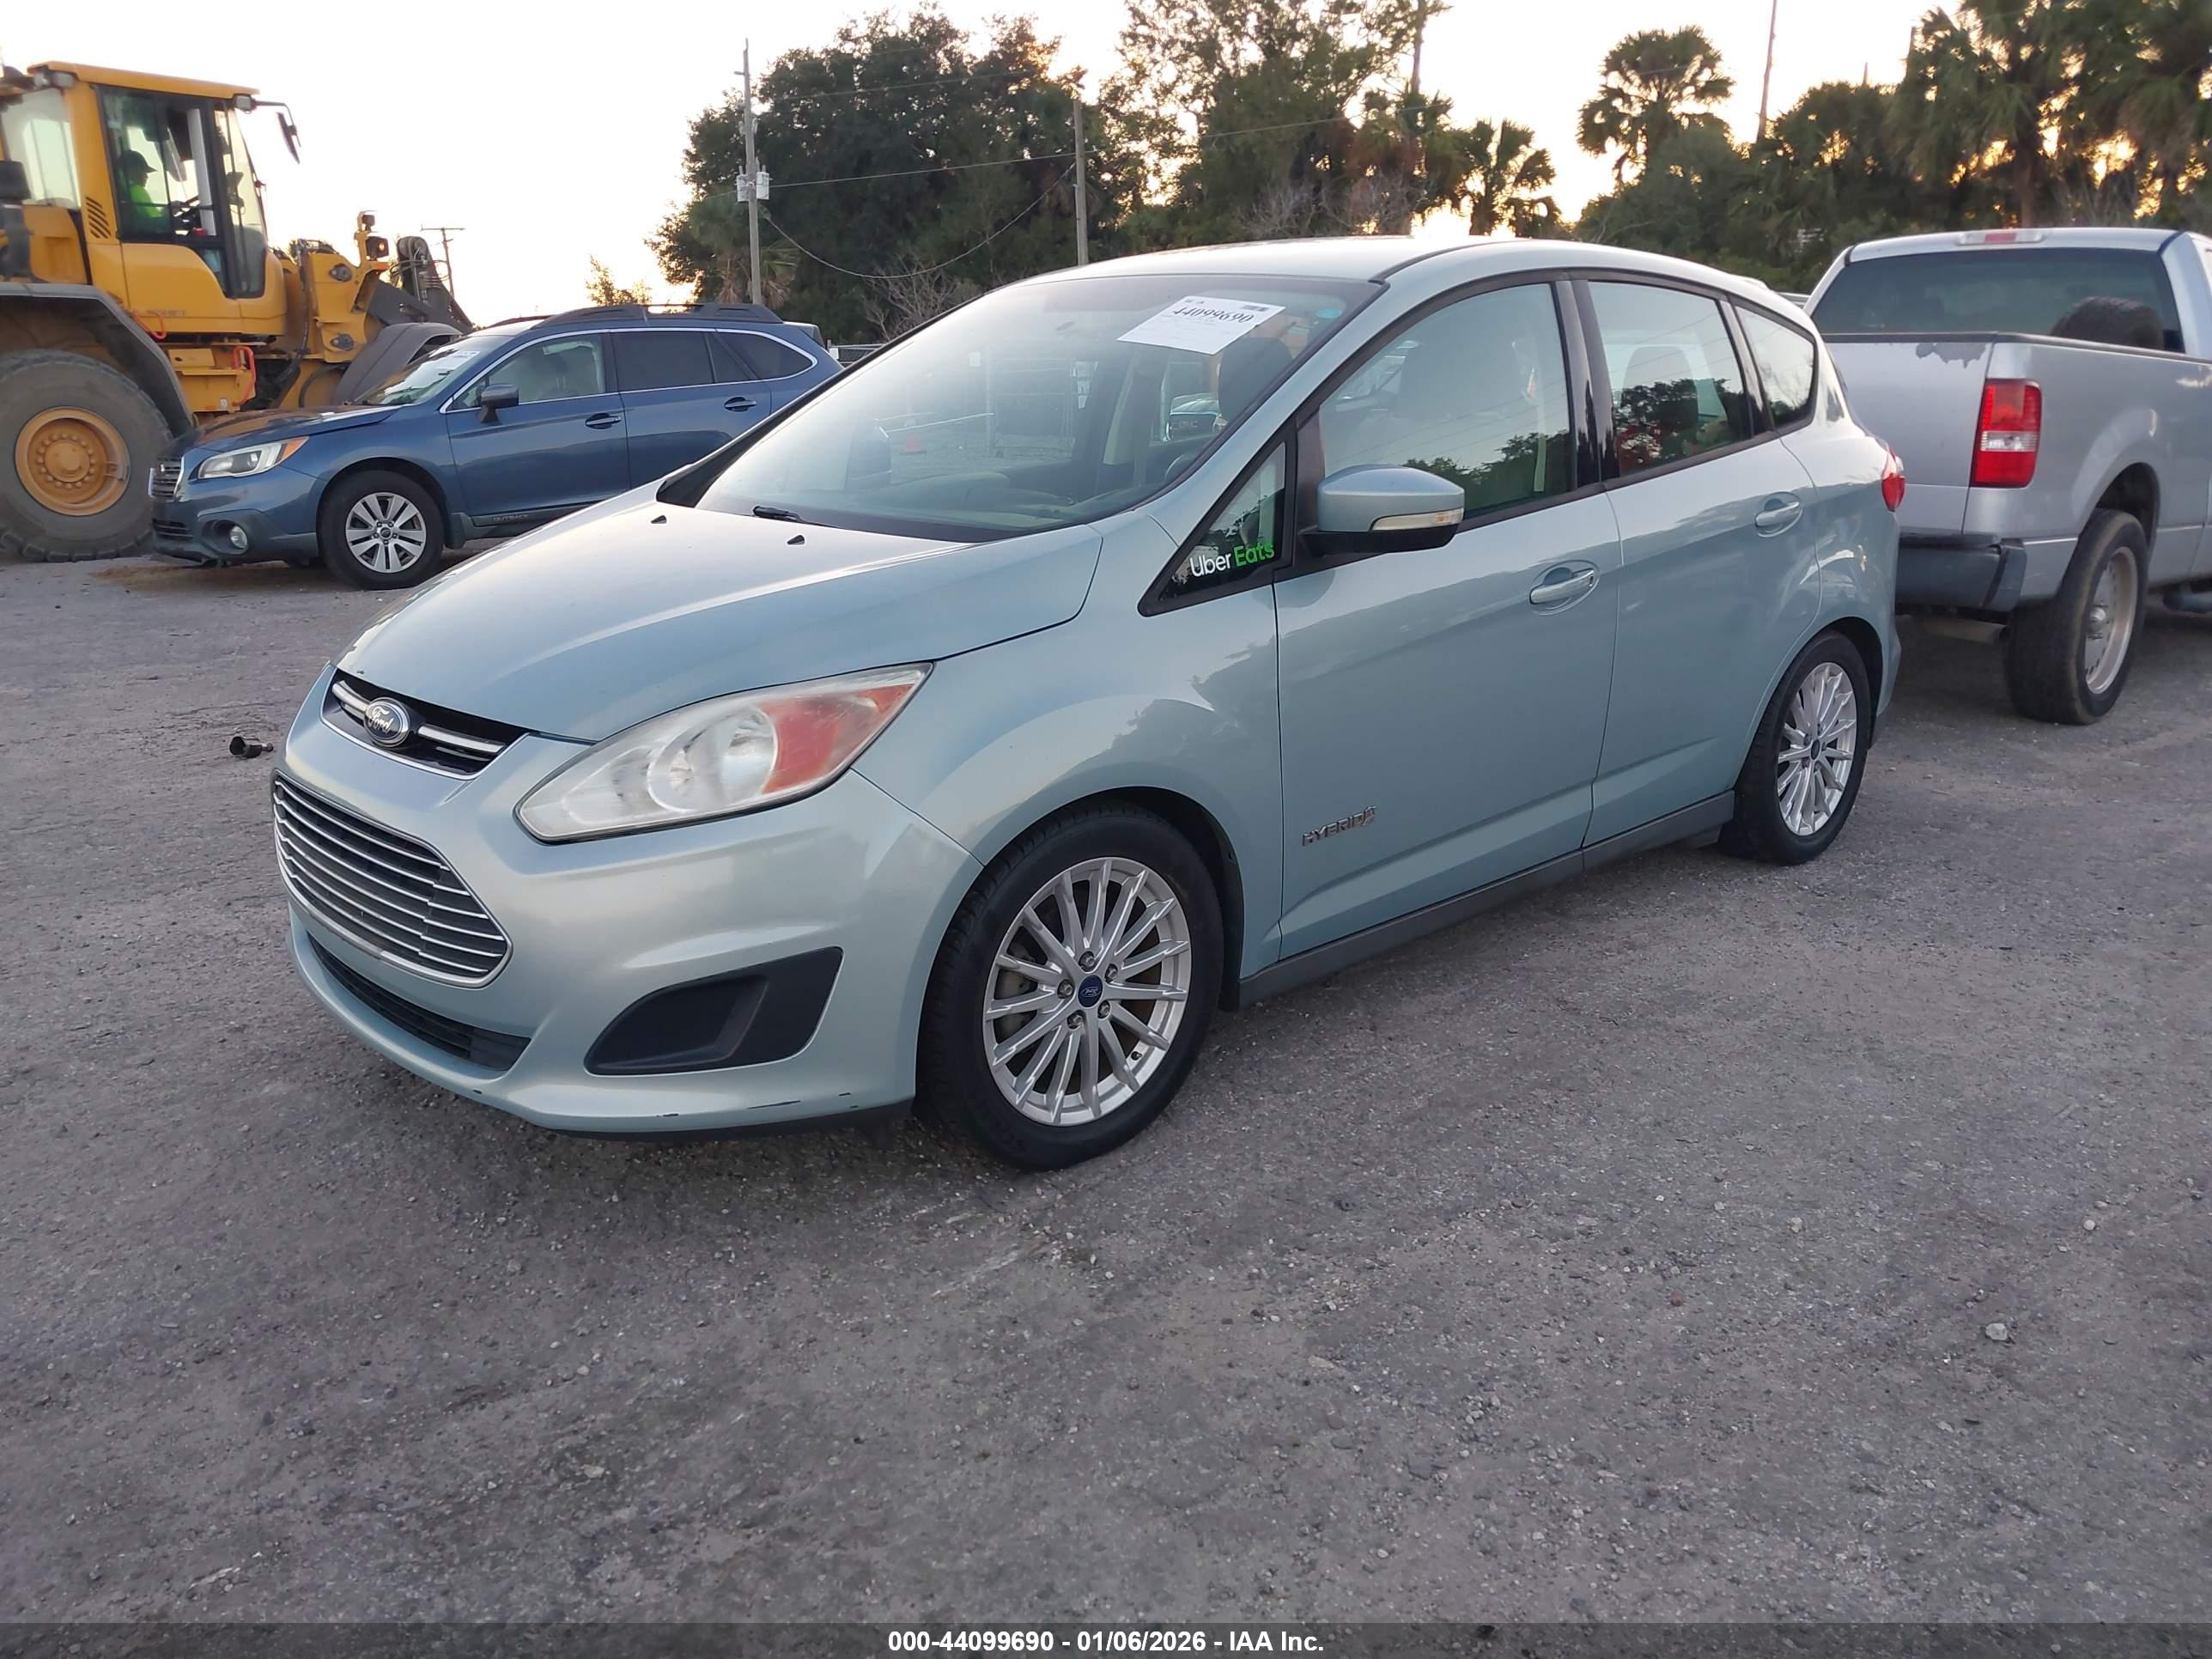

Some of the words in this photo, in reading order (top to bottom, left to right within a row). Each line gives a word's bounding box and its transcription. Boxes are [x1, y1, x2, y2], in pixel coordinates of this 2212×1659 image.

[1172, 306, 1255, 324] 44099690
[1190, 552, 1231, 577] Uber
[1233, 541, 1275, 567] Eats
[368, 706, 394, 734] Ford
[1302, 811, 1365, 846] HYBRID
